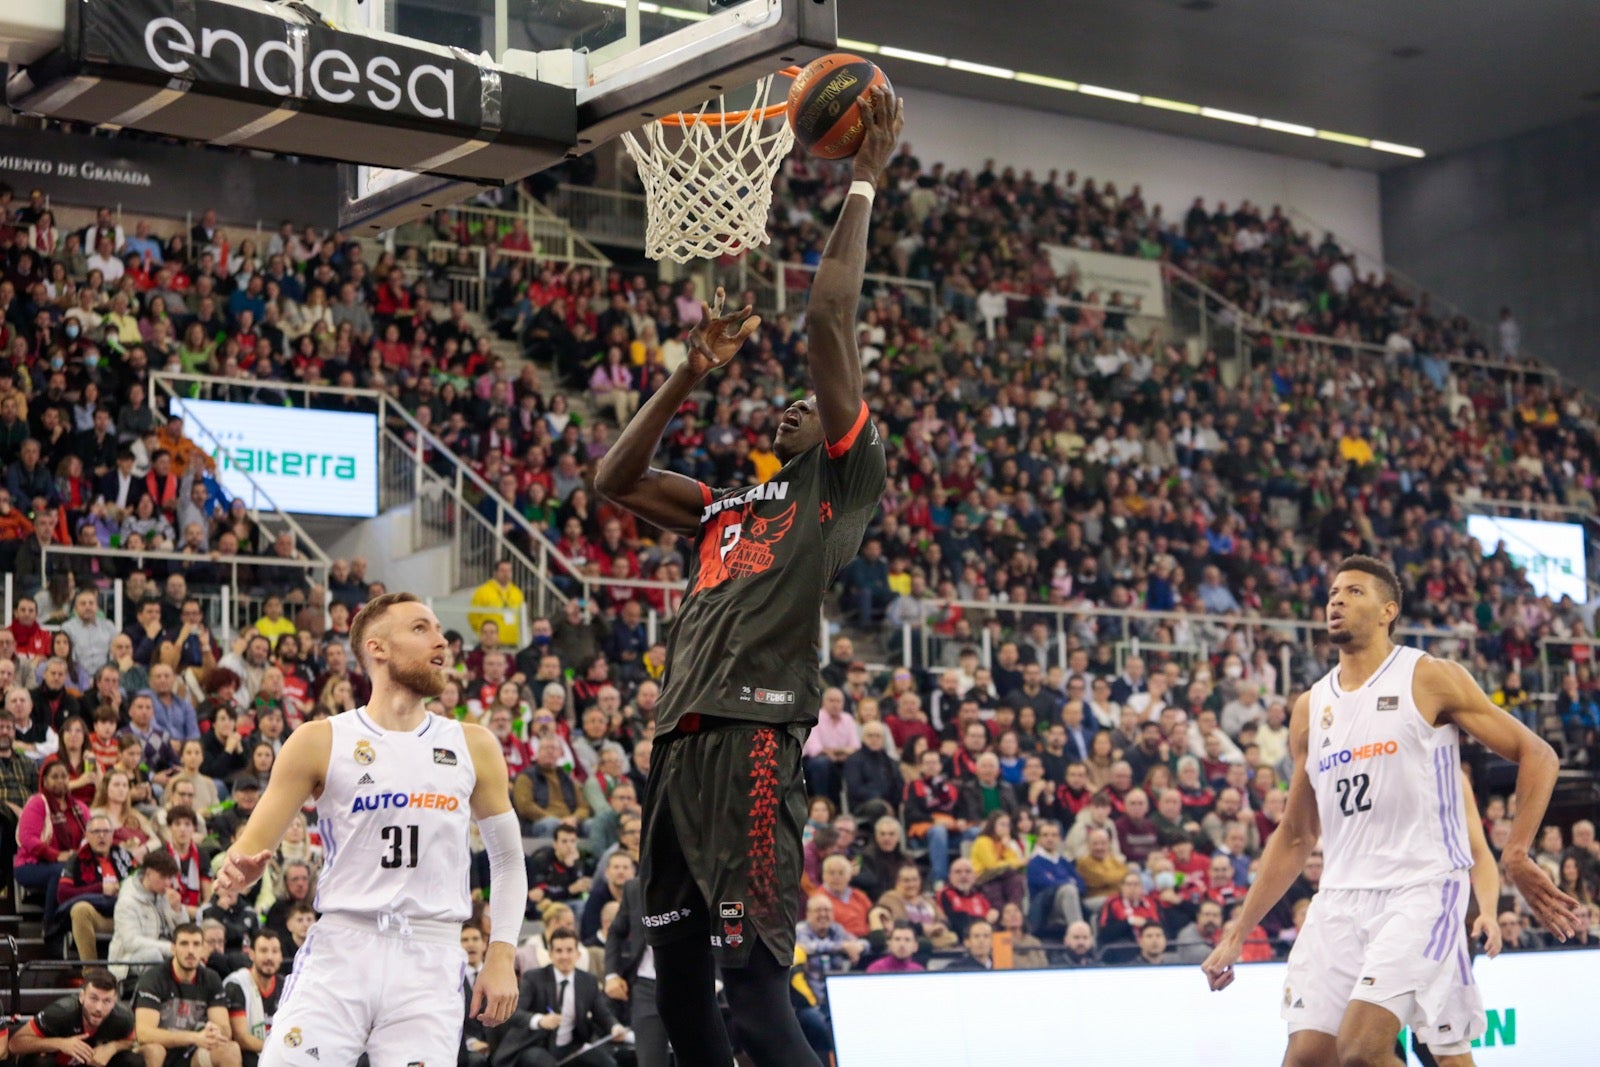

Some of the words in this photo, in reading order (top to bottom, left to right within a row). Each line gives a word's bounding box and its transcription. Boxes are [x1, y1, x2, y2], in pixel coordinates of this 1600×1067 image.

[145, 17, 455, 120] endesa
[213, 447, 355, 480] ialterra
[1319, 741, 1398, 772] AUTOHERO
[352, 793, 459, 813] AUTOHERO
[1337, 773, 1372, 817] 22
[381, 825, 419, 869] 31
